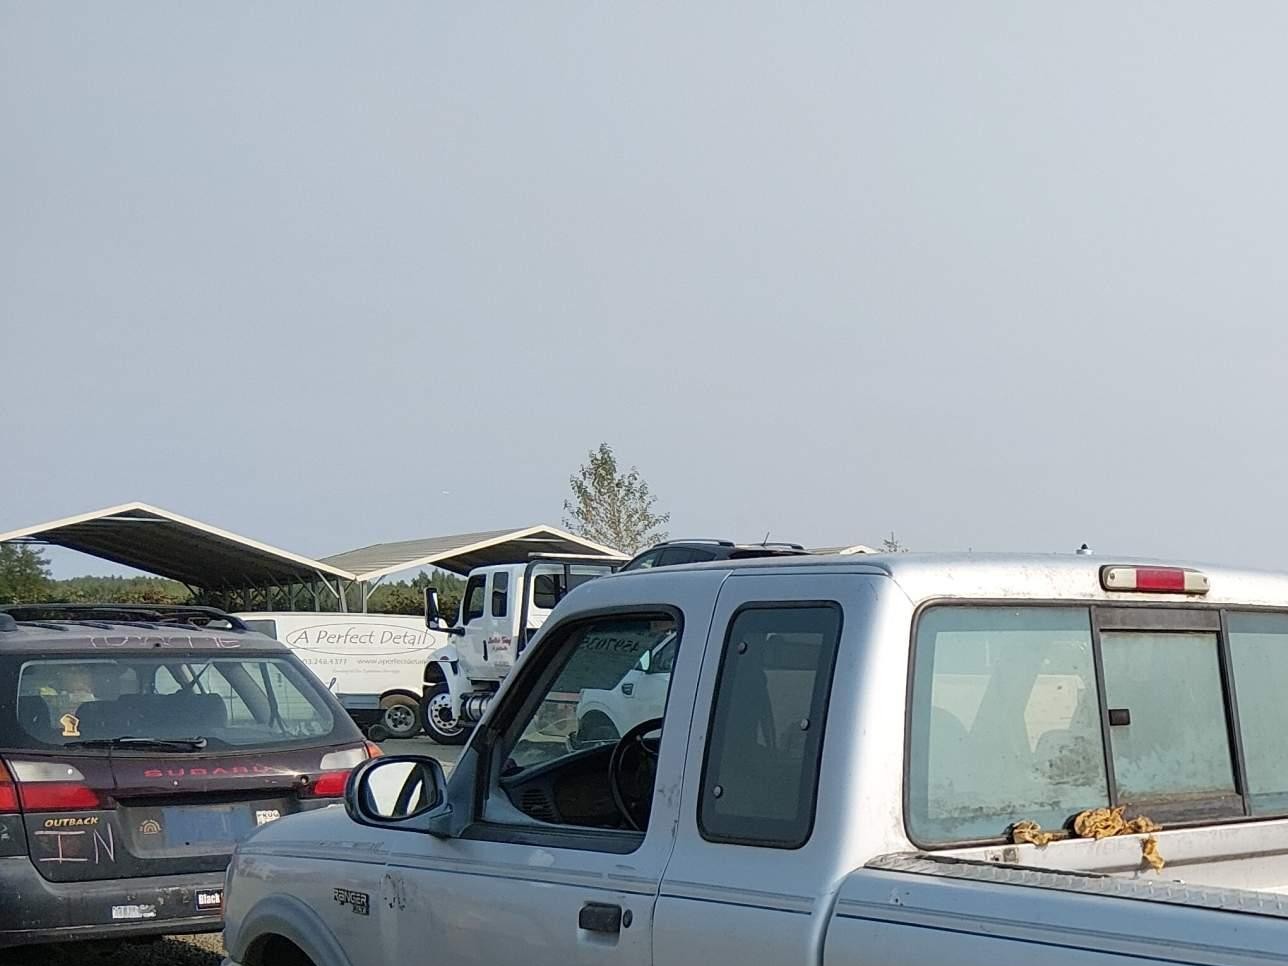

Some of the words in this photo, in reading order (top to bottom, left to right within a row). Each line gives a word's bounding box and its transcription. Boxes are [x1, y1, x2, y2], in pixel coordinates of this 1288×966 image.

[293, 630, 309, 644] A
[316, 626, 375, 644] Perfect
[380, 628, 428, 646] Detail
[144, 765, 272, 778] SUBARU
[44, 816, 99, 828] OUTBACK
[198, 893, 221, 905] Black
[333, 889, 367, 906] RANGER
